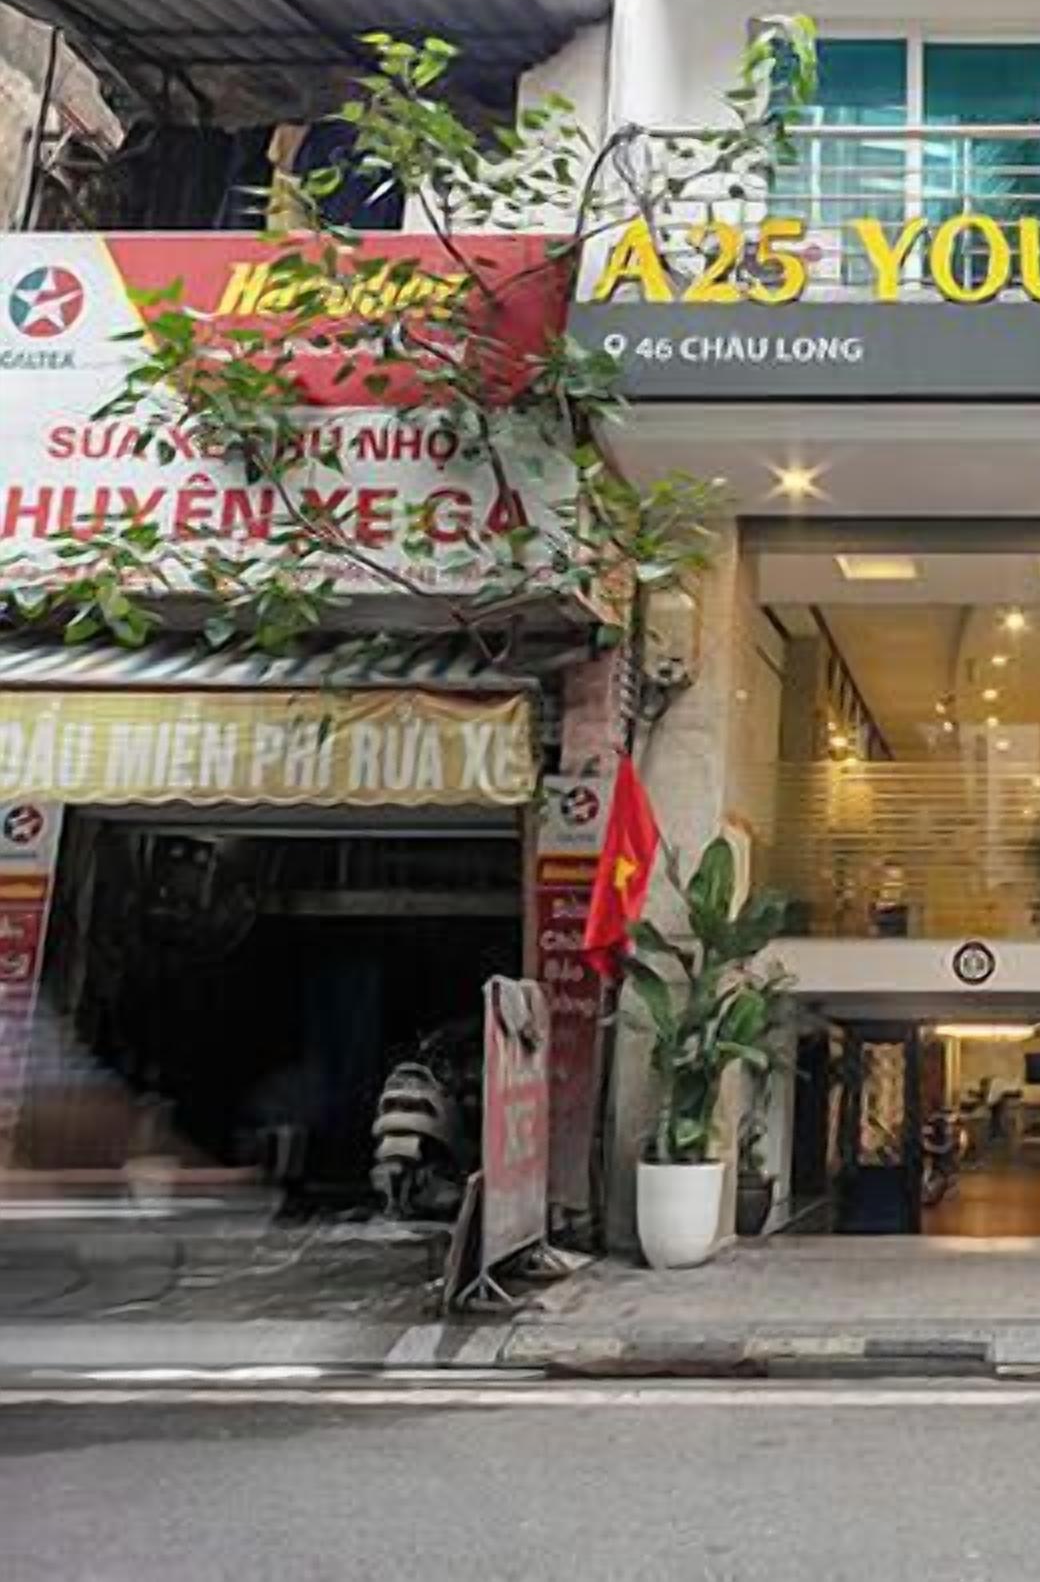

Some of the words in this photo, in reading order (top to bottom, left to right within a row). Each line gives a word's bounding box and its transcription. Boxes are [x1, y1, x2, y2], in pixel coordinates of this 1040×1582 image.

[596, 215, 807, 305] A25
[634, 337, 673, 362] 46
[775, 336, 867, 364] LONG
